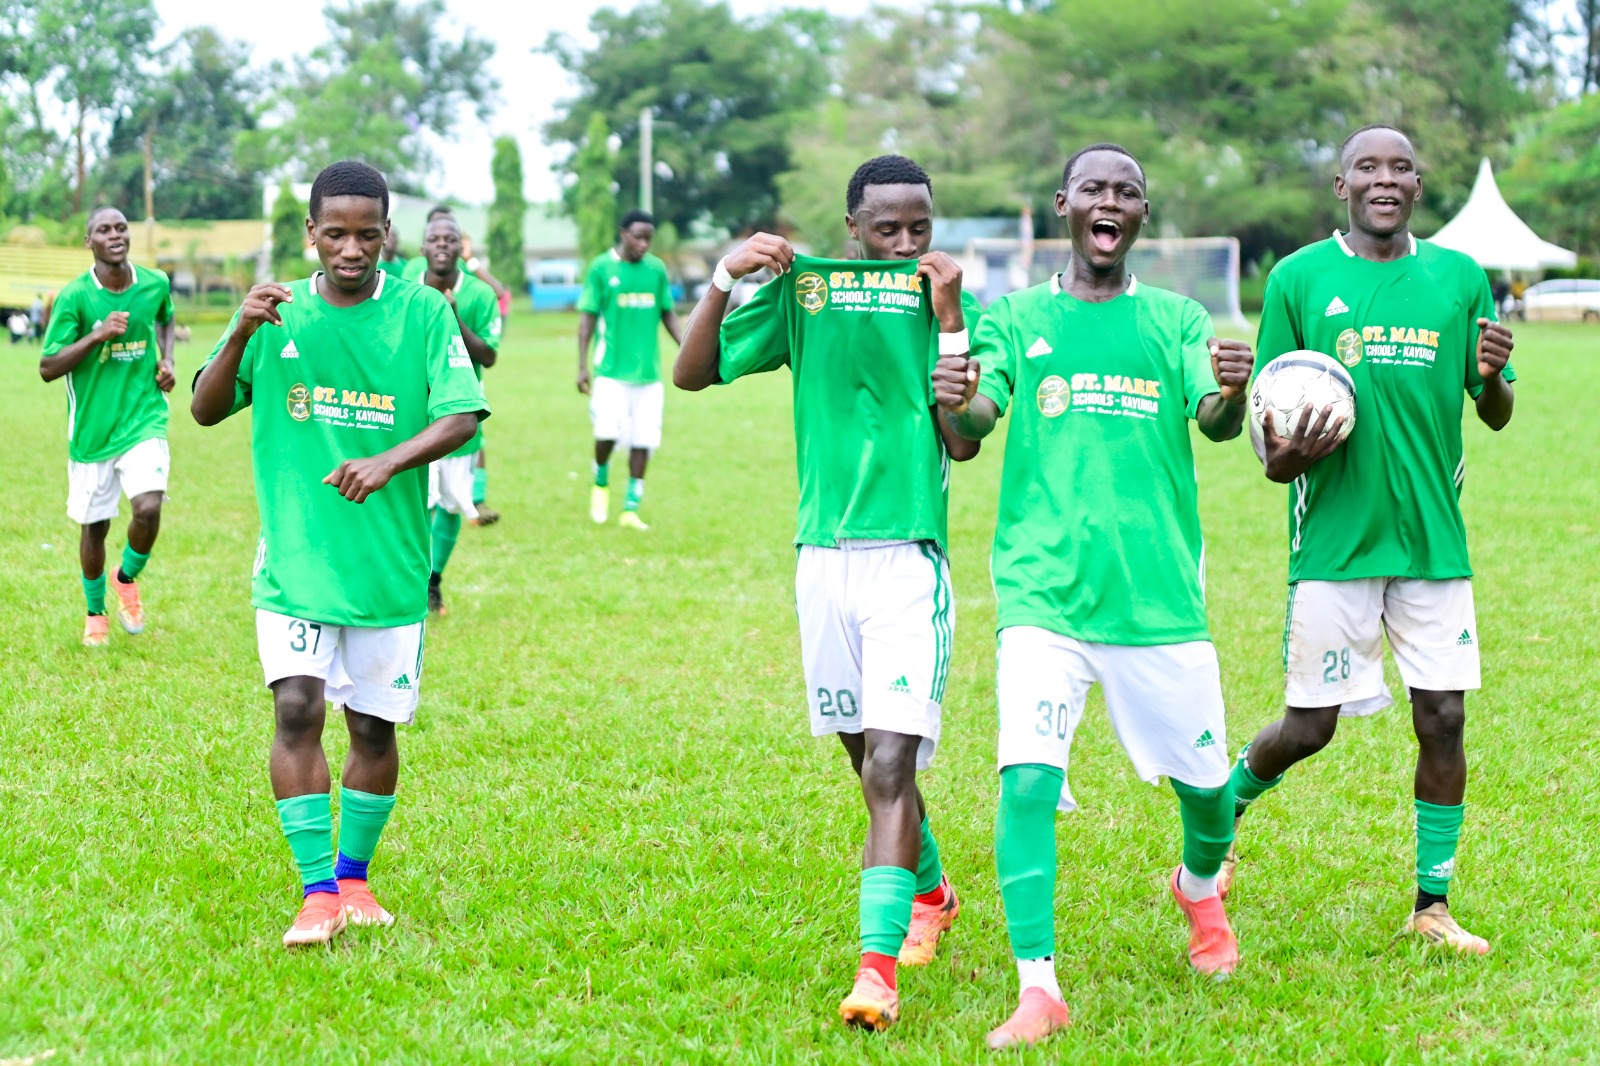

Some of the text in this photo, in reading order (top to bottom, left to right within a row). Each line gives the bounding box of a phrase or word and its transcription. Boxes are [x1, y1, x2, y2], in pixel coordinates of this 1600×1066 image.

[829, 271, 922, 293] ST. MARK
[831, 291, 872, 304] SCHOOLS
[878, 291, 920, 309] KAYUNGA
[1362, 326, 1440, 348] ST. MARK
[1071, 373, 1160, 398] ST. MARK
[313, 386, 396, 411] ST. MARK
[1072, 392, 1114, 407] SCHOOLS
[1121, 395, 1158, 414] KAYUNGA
[313, 403, 349, 419] SCHOOLS
[355, 410, 394, 425] KAYUNGA
[288, 619, 322, 655] 37
[1322, 646, 1350, 684] 28
[390, 682, 412, 690] adidas
[817, 687, 857, 717] 20
[1035, 700, 1068, 740] 30
[1193, 738, 1216, 749] adidas
